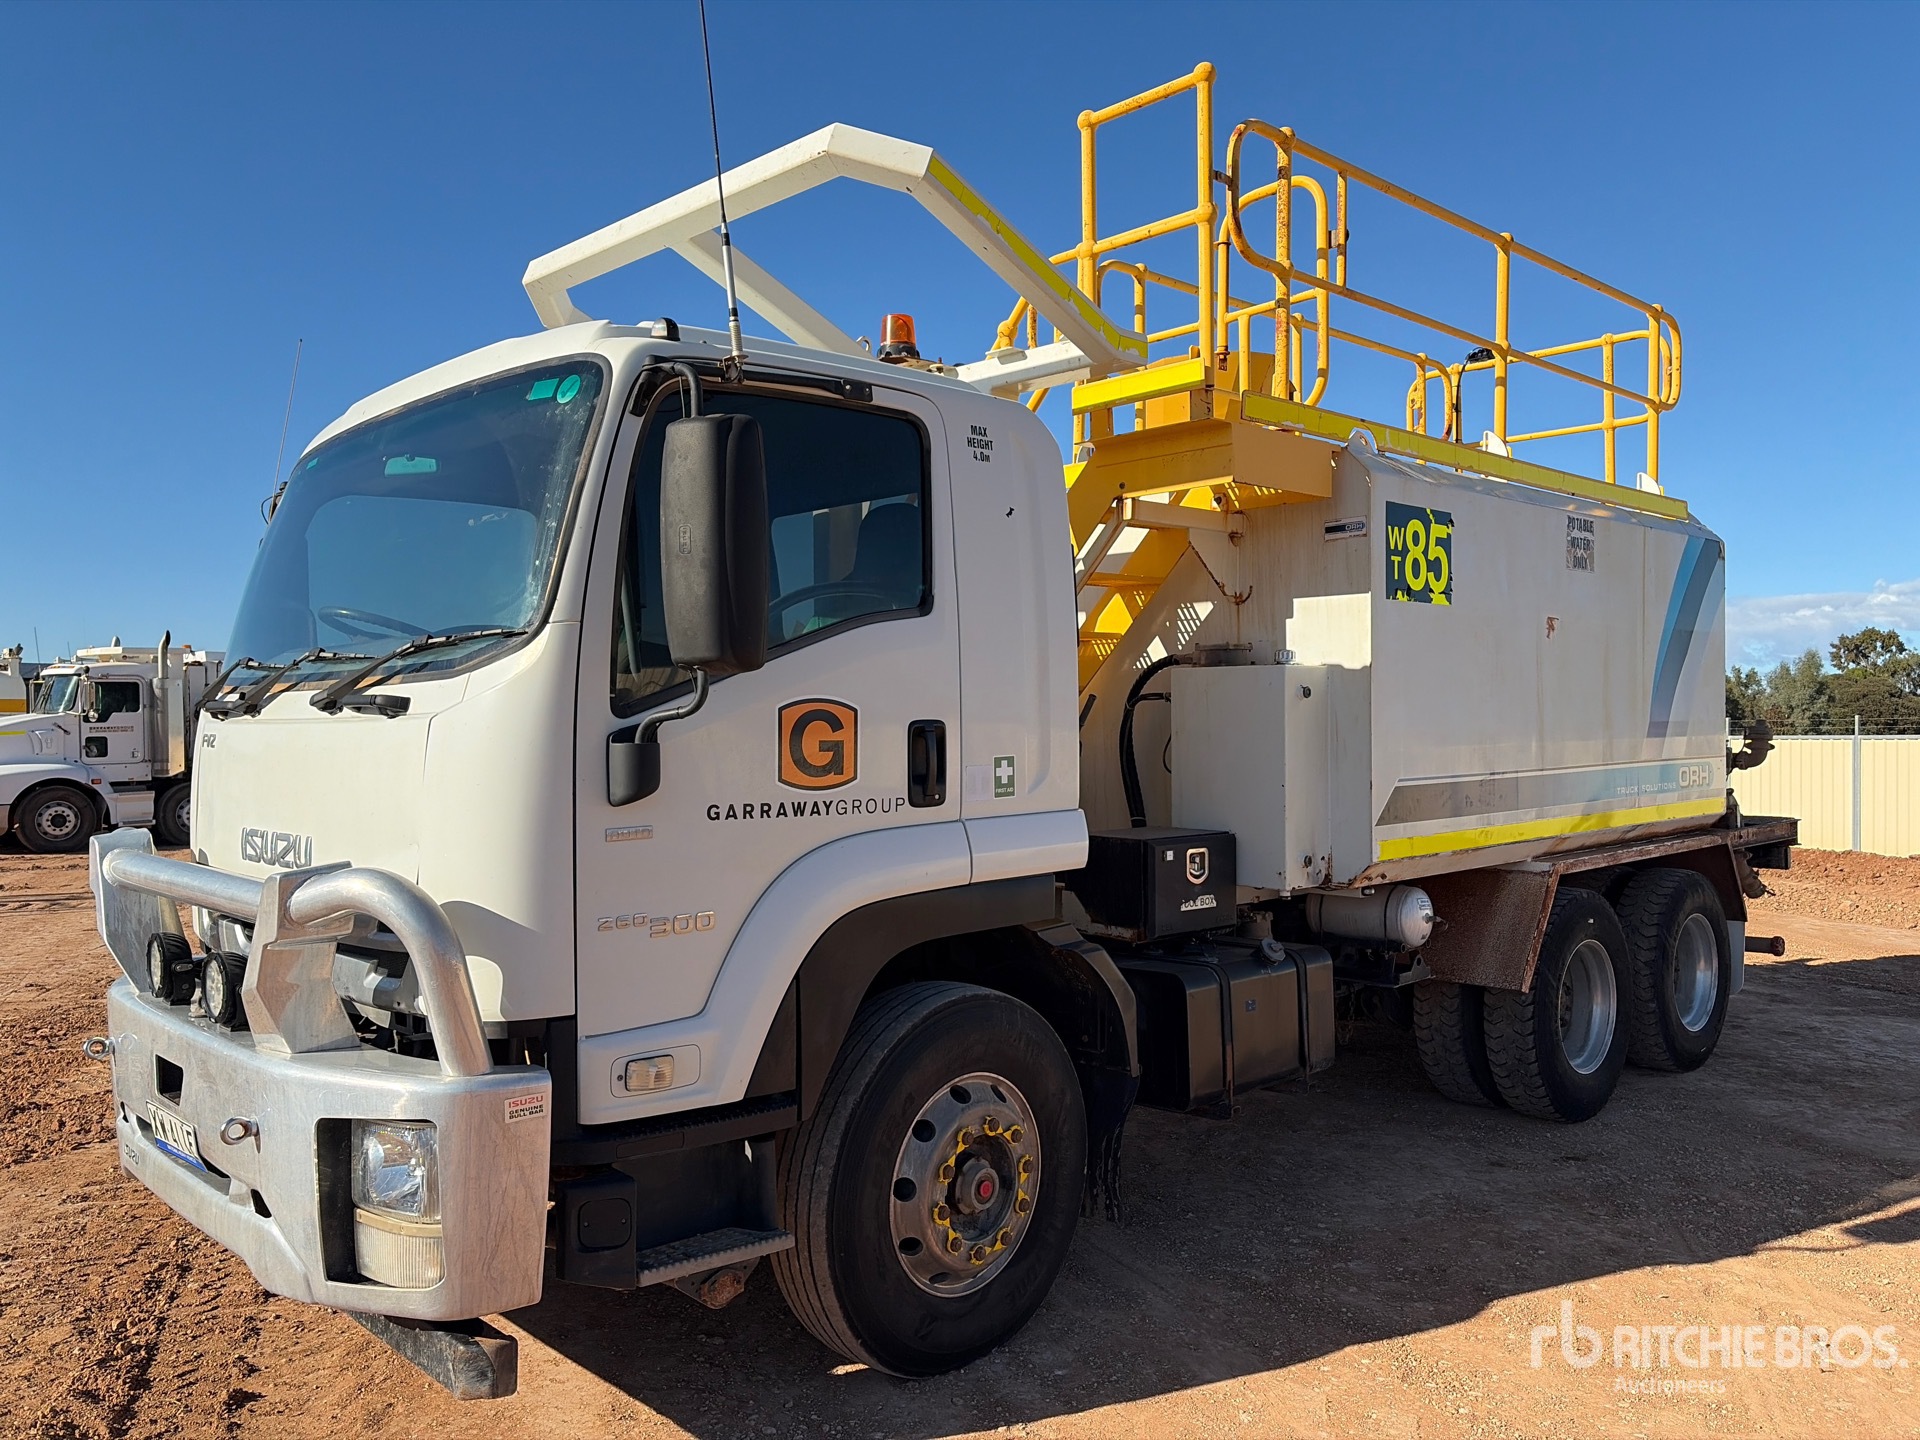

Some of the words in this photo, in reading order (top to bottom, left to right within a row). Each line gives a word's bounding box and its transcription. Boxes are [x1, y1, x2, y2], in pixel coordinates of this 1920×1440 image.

[970, 425, 988, 438] MAX
[967, 437, 994, 451] HEIGHT
[1567, 516, 1594, 534] POTABLE
[1570, 536, 1591, 551] WATER
[1405, 519, 1449, 594] 85
[1573, 555, 1587, 570] ONLY
[789, 709, 844, 777] G
[1616, 786, 1639, 794] TRUCK
[1642, 782, 1676, 792] SOLUTIONS
[1678, 765, 1710, 787] ORH
[241, 827, 312, 869] ISUZU
[1200, 897, 1214, 906] BOX
[508, 1096, 544, 1108] ISUZU
[509, 1104, 544, 1115] GENUINE
[509, 1112, 528, 1120] BULL
